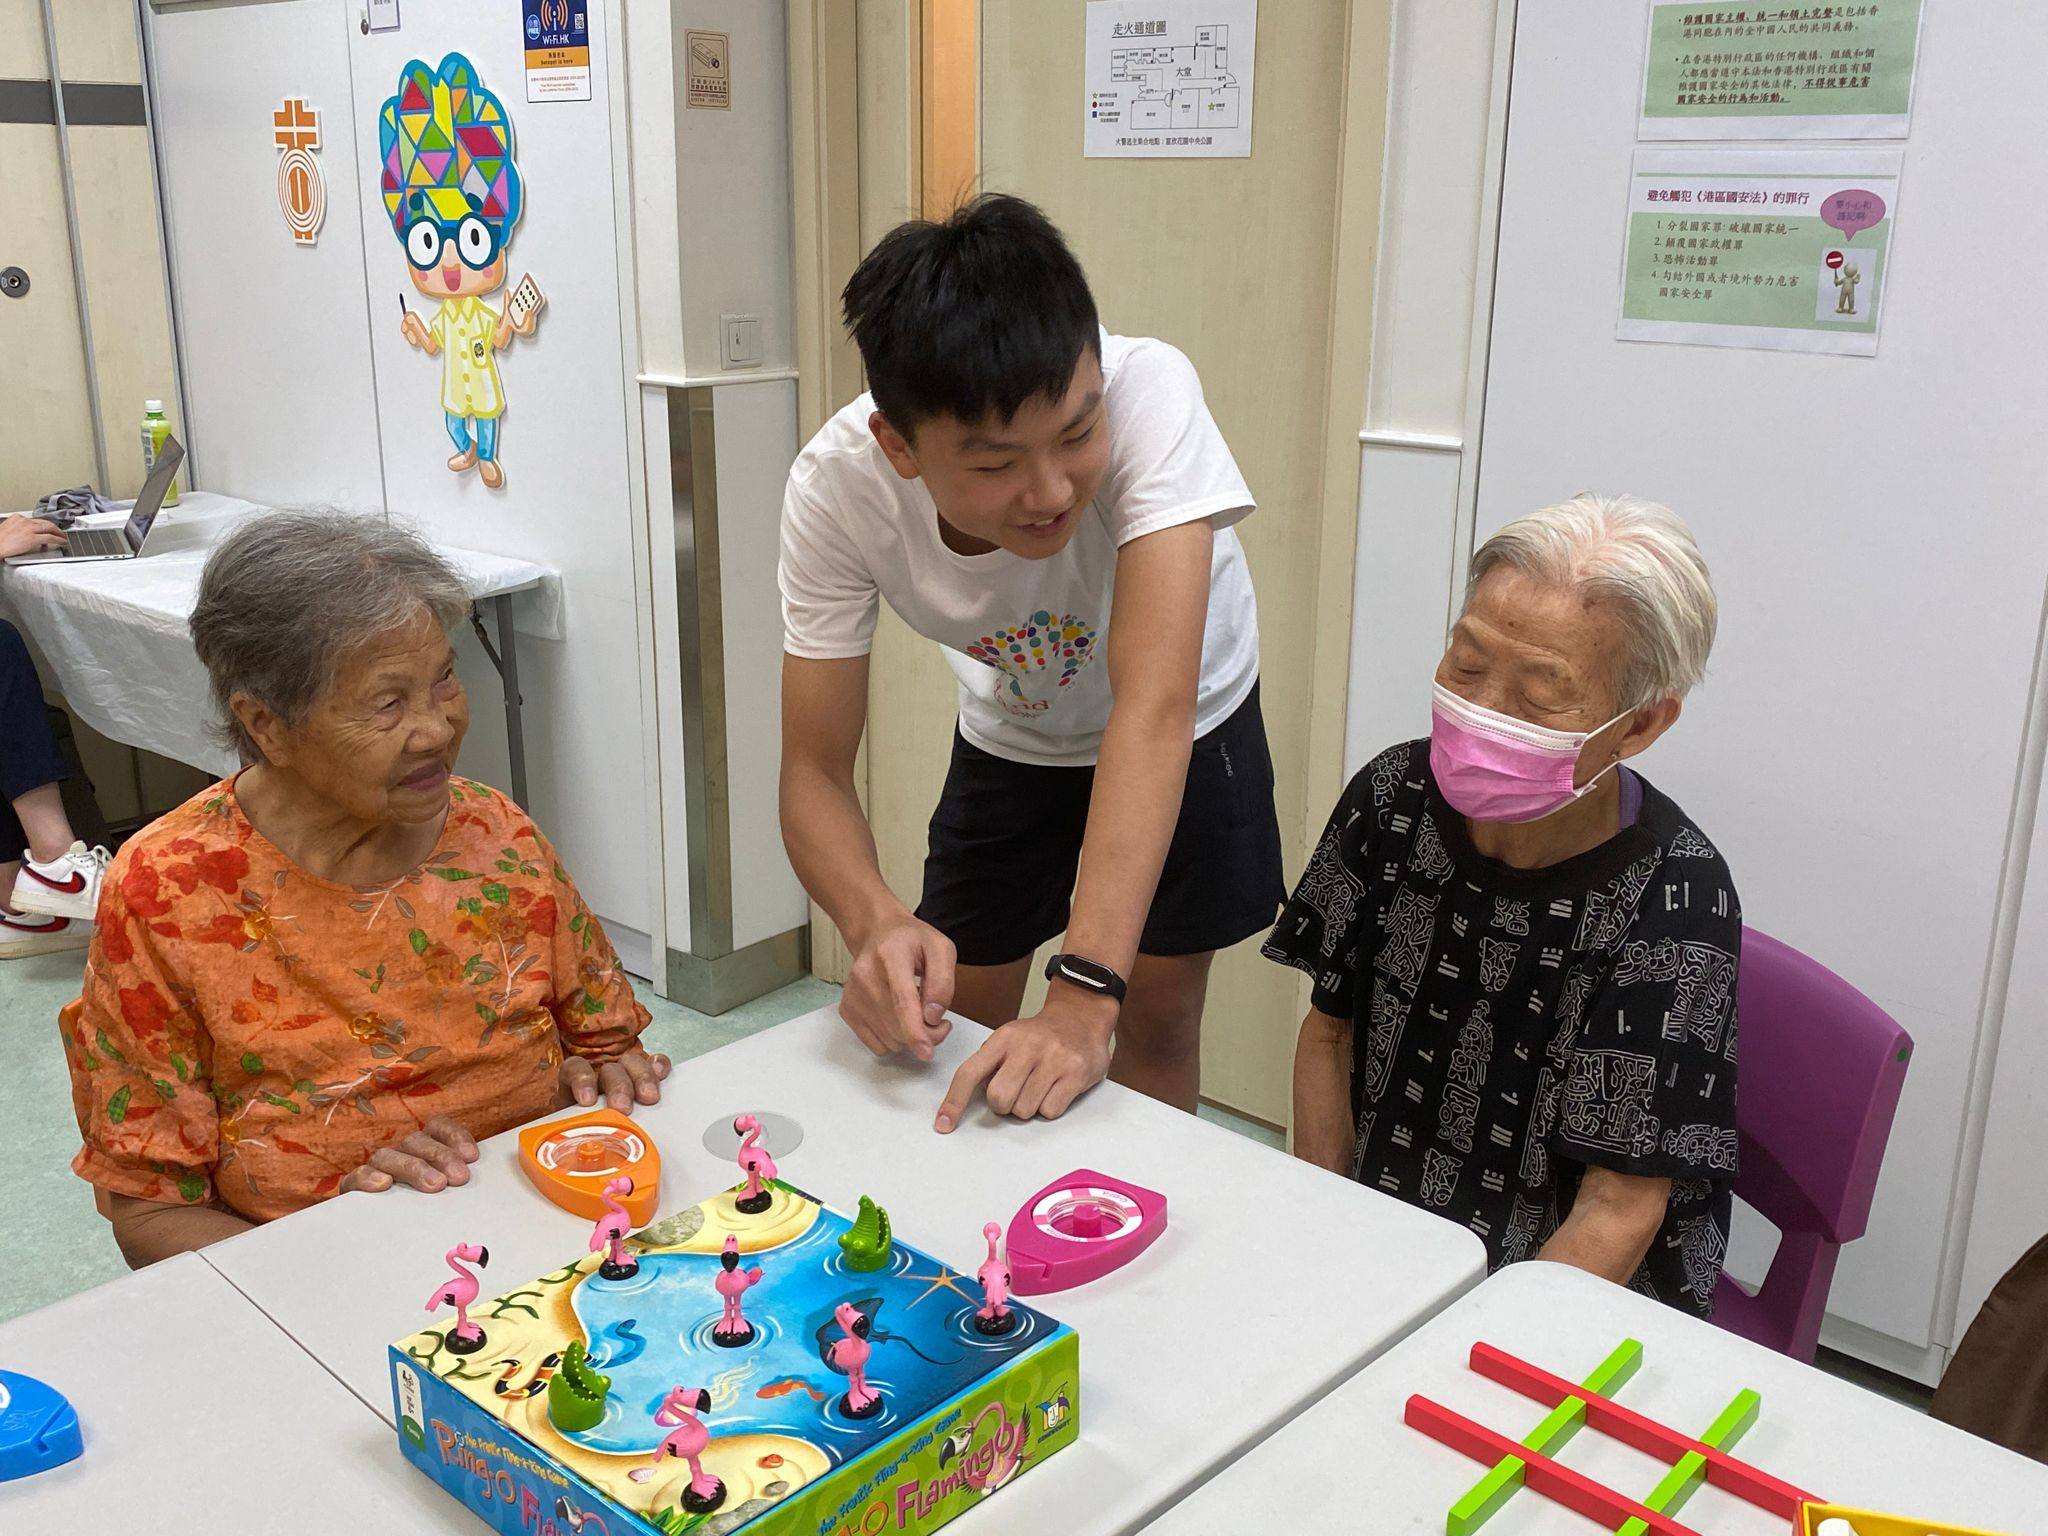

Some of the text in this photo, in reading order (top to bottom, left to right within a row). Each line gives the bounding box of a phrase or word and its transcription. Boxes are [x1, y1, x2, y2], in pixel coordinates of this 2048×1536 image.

[1112, 20, 1167, 36] 走火通道圖
[1659, 288, 1713, 300] 國家安全罪
